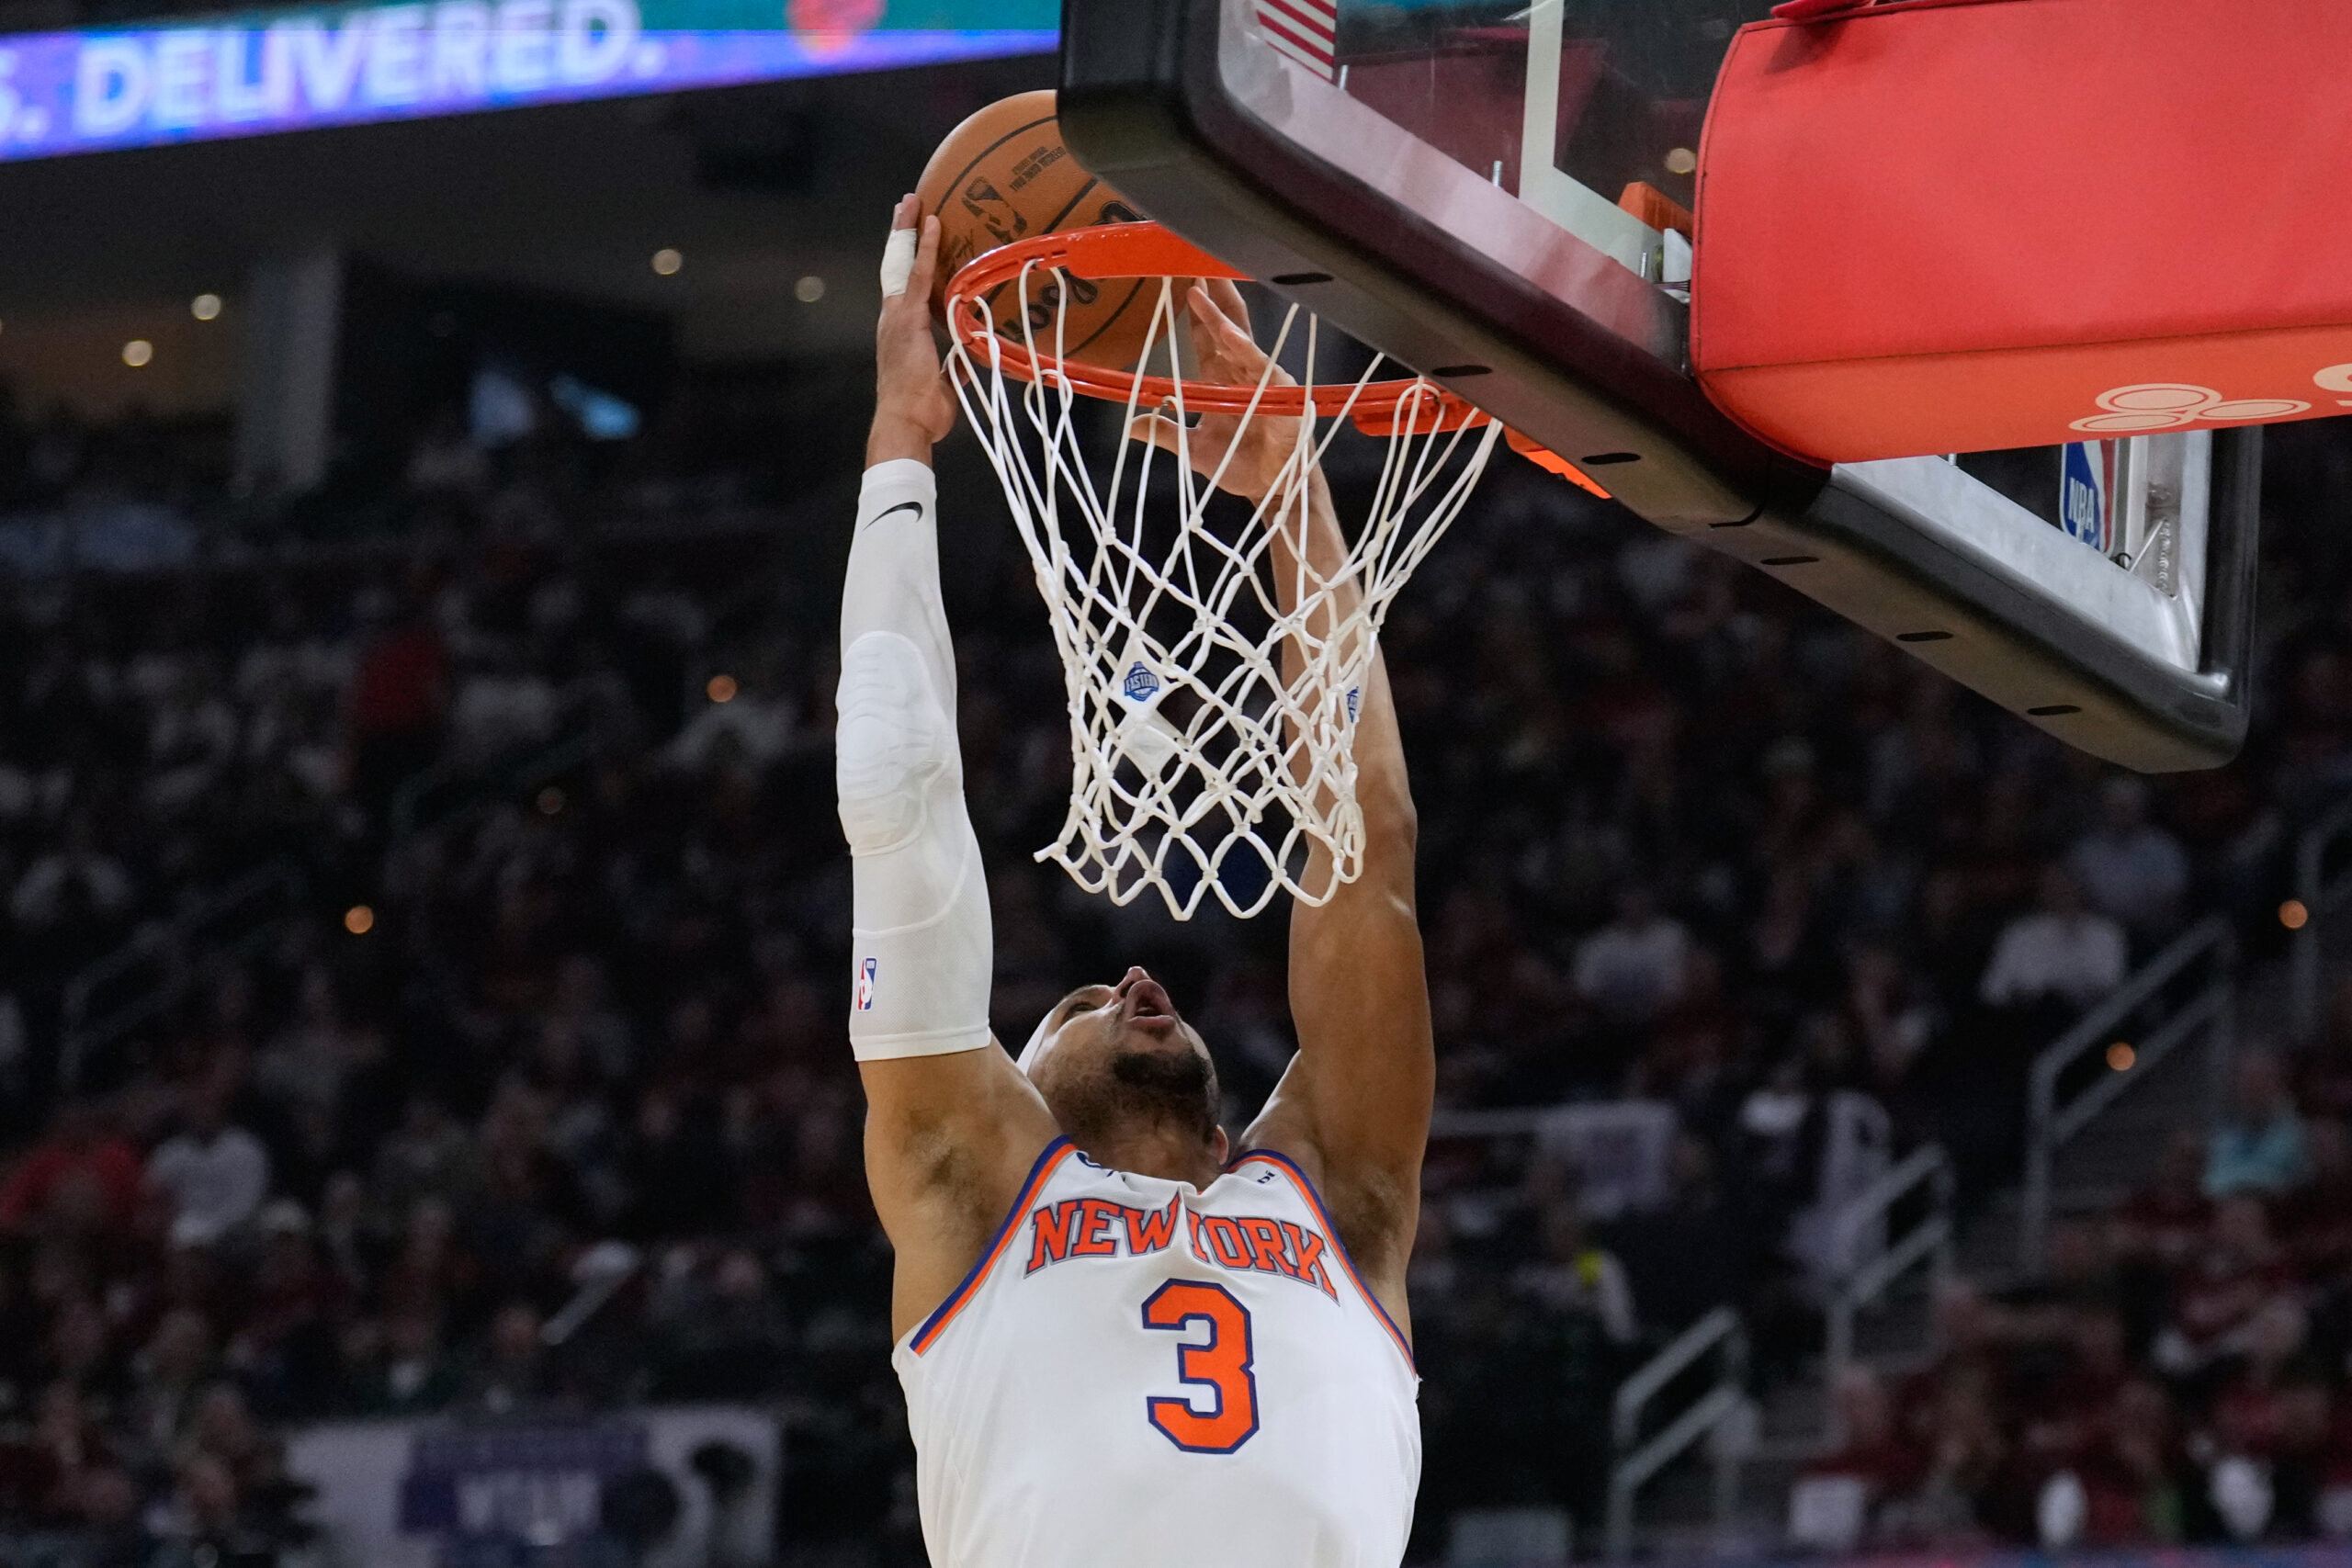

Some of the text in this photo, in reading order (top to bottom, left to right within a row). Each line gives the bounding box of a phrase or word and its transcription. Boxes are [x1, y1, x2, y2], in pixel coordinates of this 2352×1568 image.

[74, 0, 667, 138] DELIVERED.
[2067, 476, 2095, 536] NBA
[1023, 1190, 1182, 1279] NEW
[1141, 1278, 1260, 1454] 3
